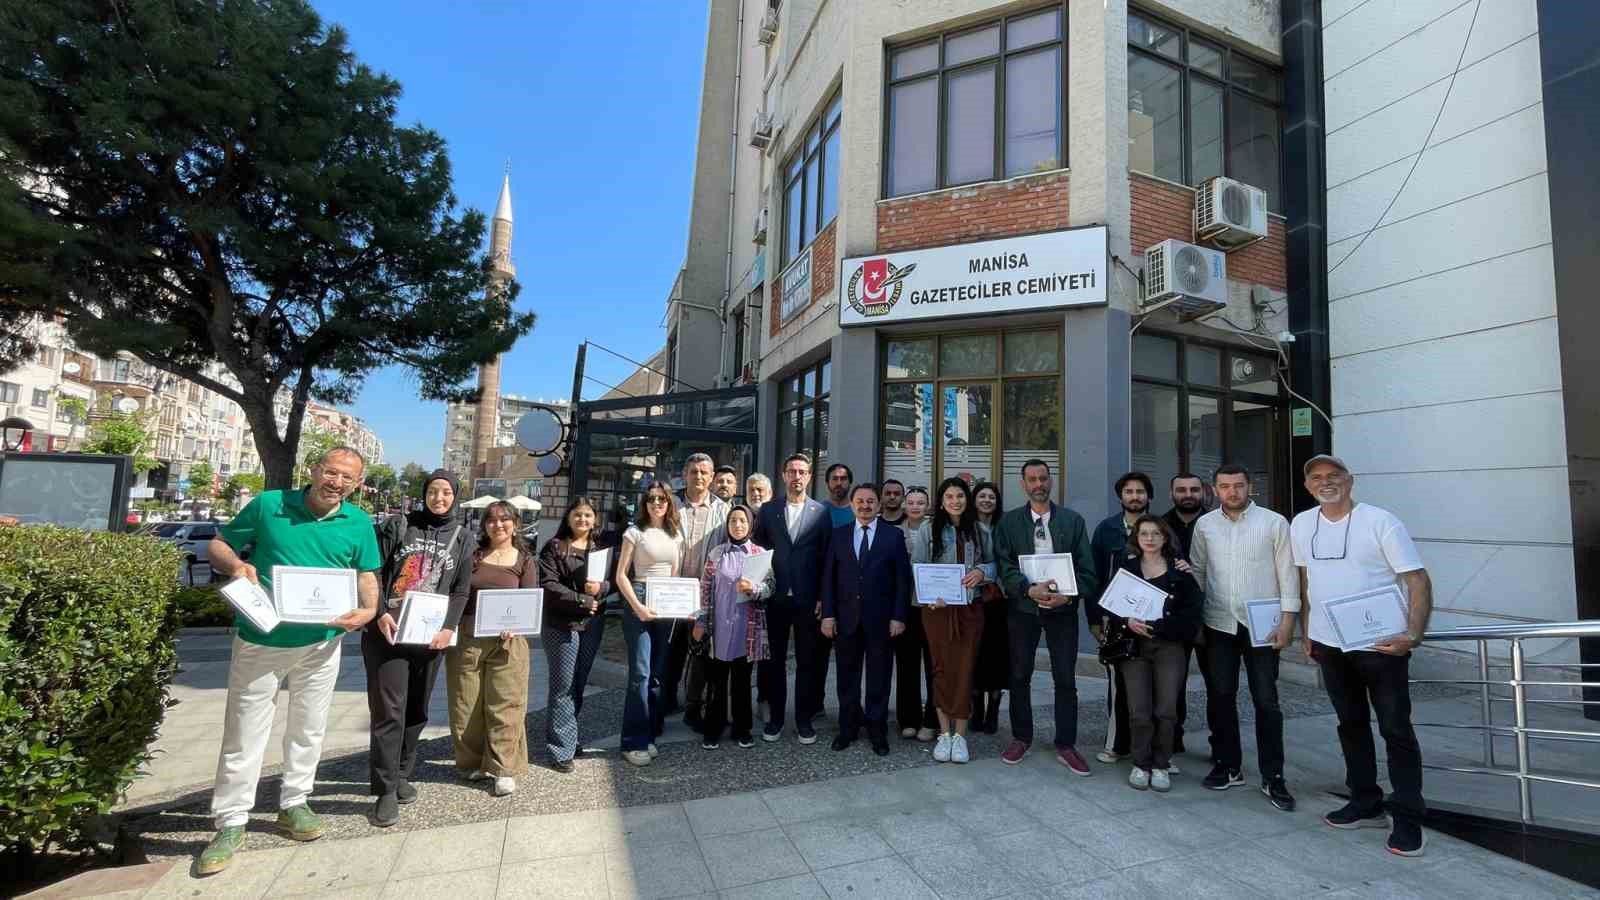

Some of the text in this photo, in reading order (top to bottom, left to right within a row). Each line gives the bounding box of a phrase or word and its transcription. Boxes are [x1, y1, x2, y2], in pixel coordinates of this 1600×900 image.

[968, 252, 1029, 274] MANİSA
[910, 279, 1012, 305] GAZETECİLER
[1017, 268, 1096, 296] CEMİYETİ
